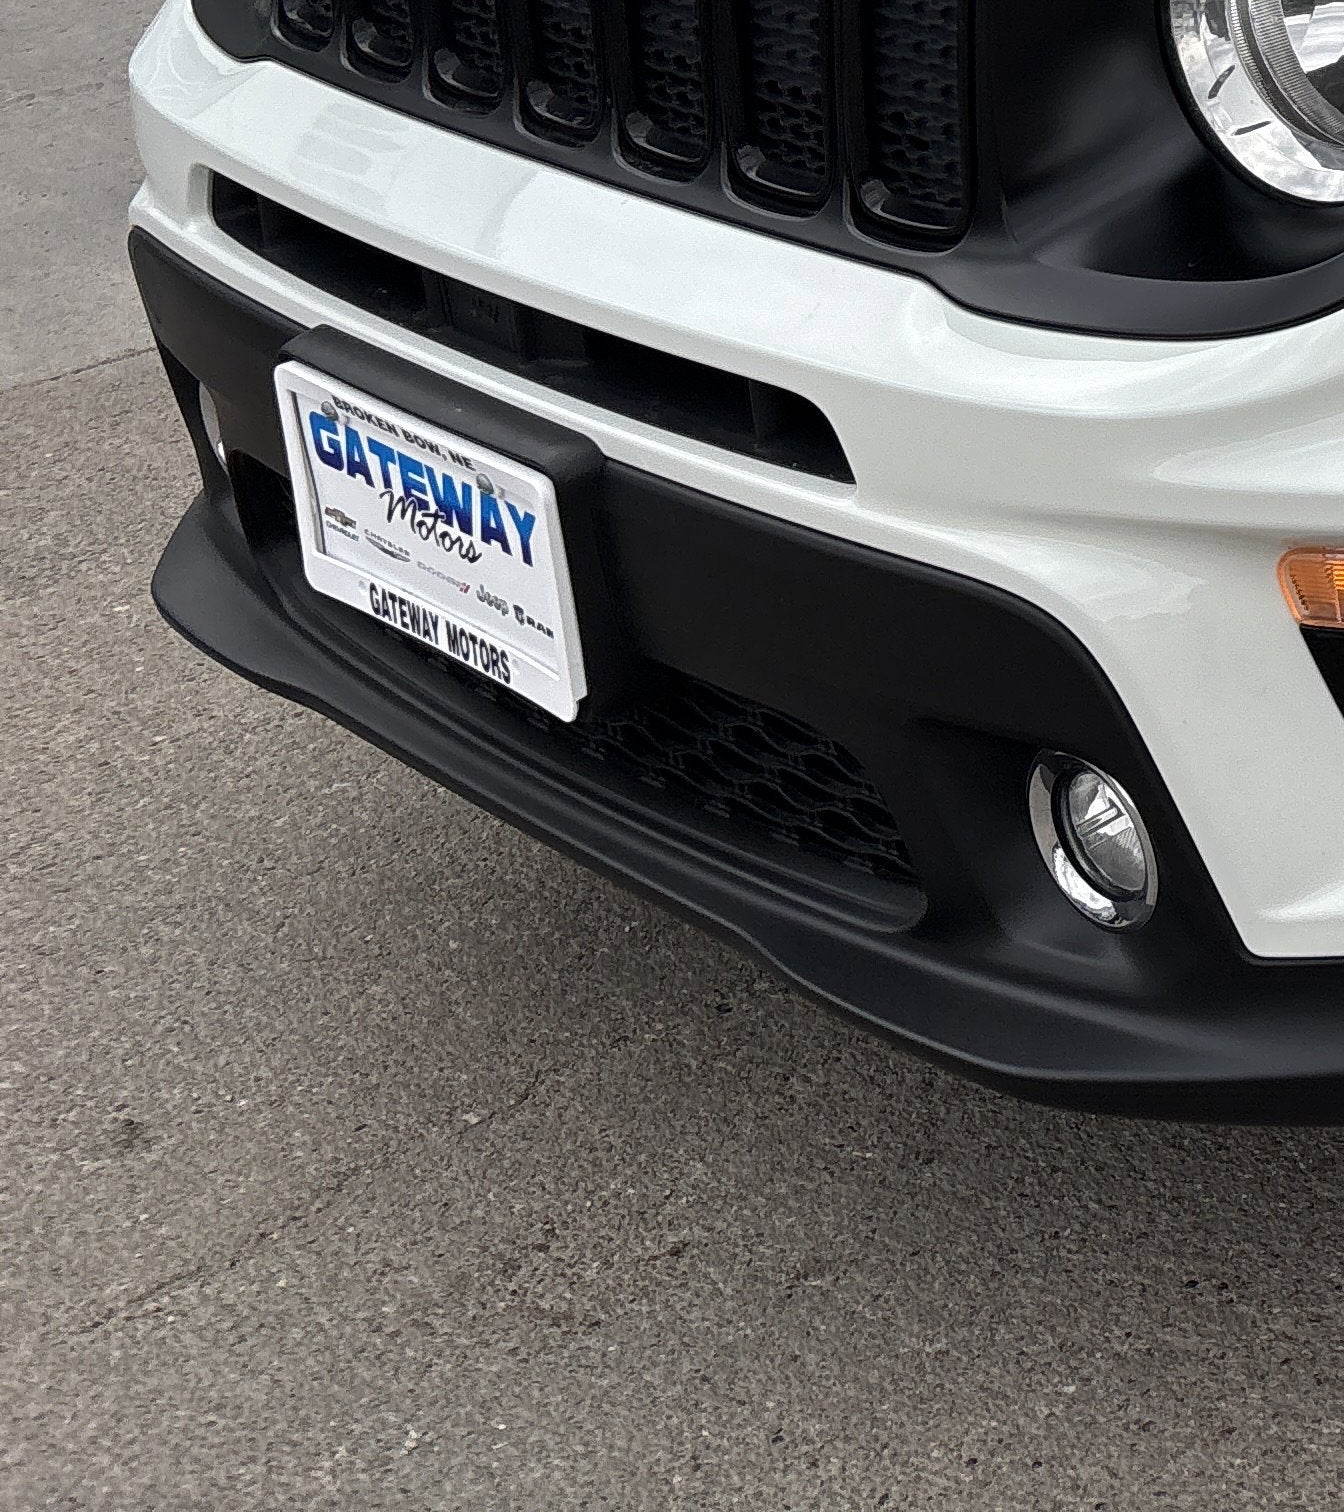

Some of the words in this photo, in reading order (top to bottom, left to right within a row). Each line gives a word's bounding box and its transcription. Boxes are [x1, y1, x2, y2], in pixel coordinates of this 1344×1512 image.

[331, 394, 400, 438] BROKEN
[402, 428, 448, 463] BOW,
[449, 446, 477, 471] NE
[308, 409, 536, 567] GATEWAY
[378, 488, 483, 565] Motors
[368, 581, 440, 647] GATEWAY
[445, 617, 512, 686] MOTORS
